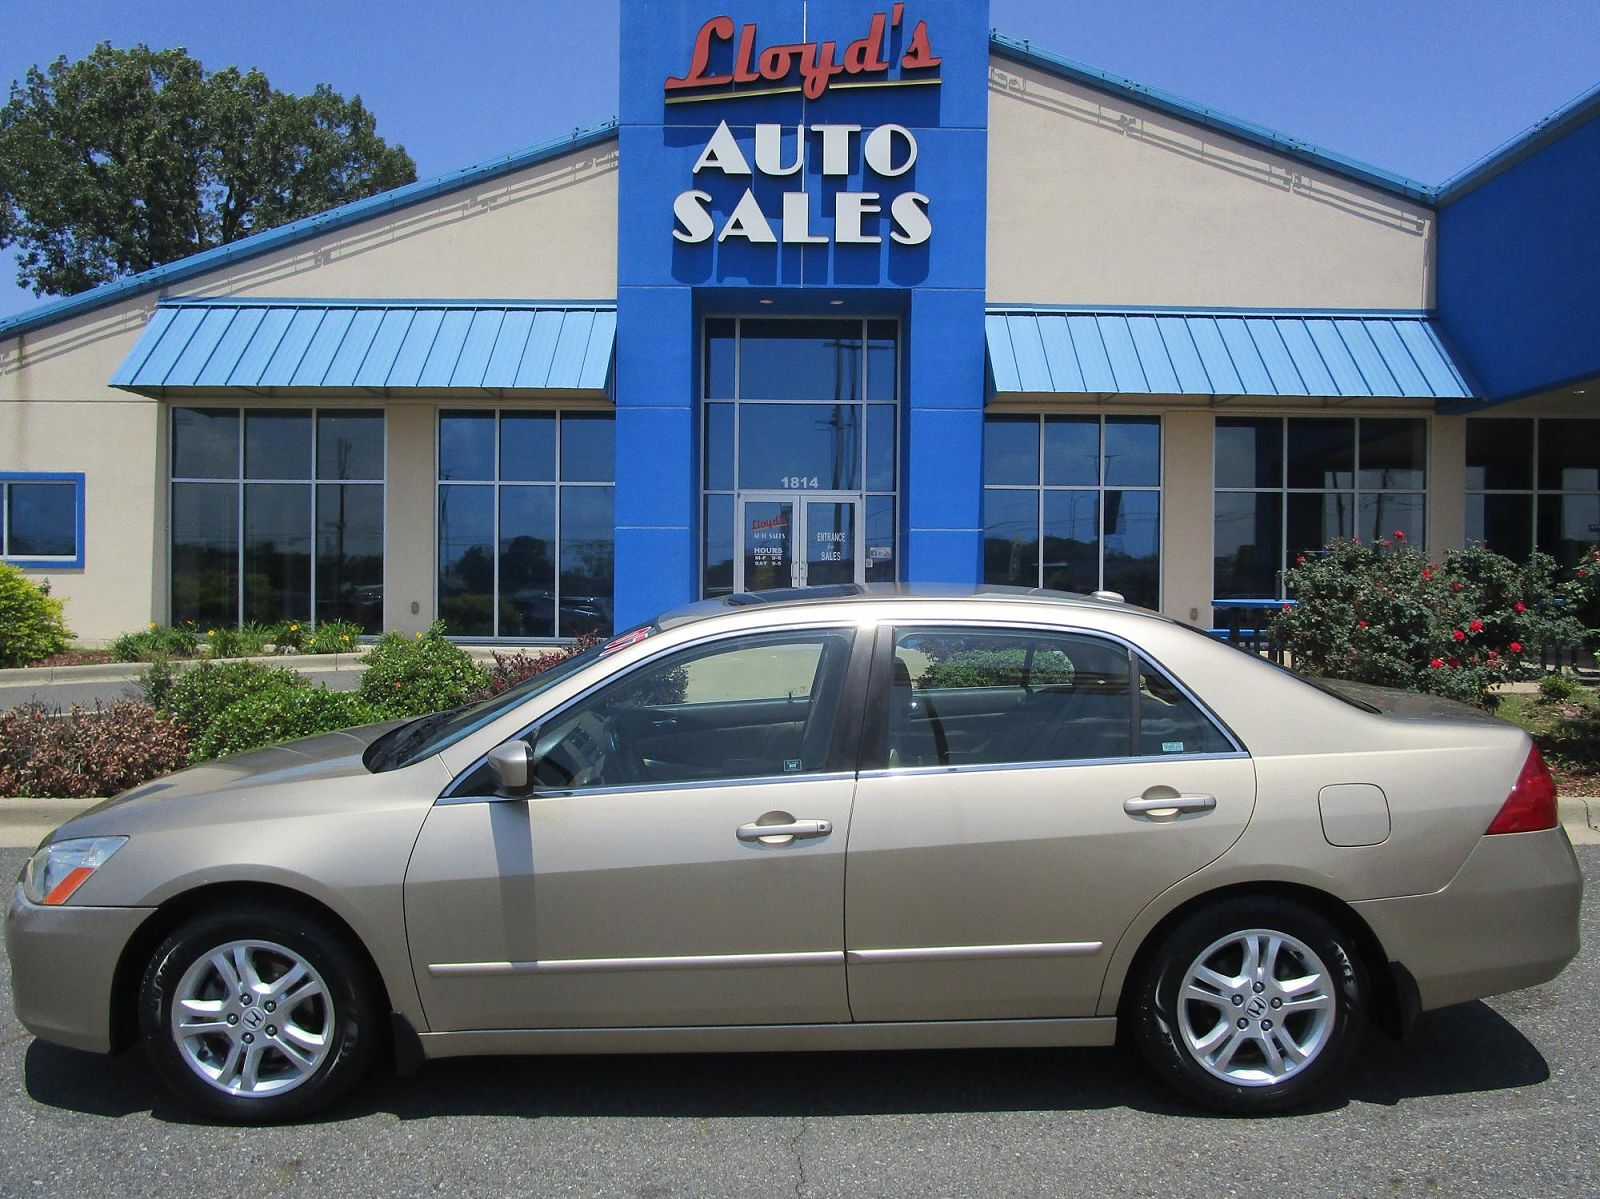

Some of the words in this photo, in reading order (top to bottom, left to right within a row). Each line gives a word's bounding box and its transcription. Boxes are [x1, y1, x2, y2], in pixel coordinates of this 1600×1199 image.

[664, 3, 943, 100] Lloyd's
[692, 119, 918, 177] AUTO
[672, 187, 932, 245] SALES
[781, 476, 819, 489] 1814
[817, 532, 846, 542] ENTRANCE
[820, 551, 841, 561] SALES
